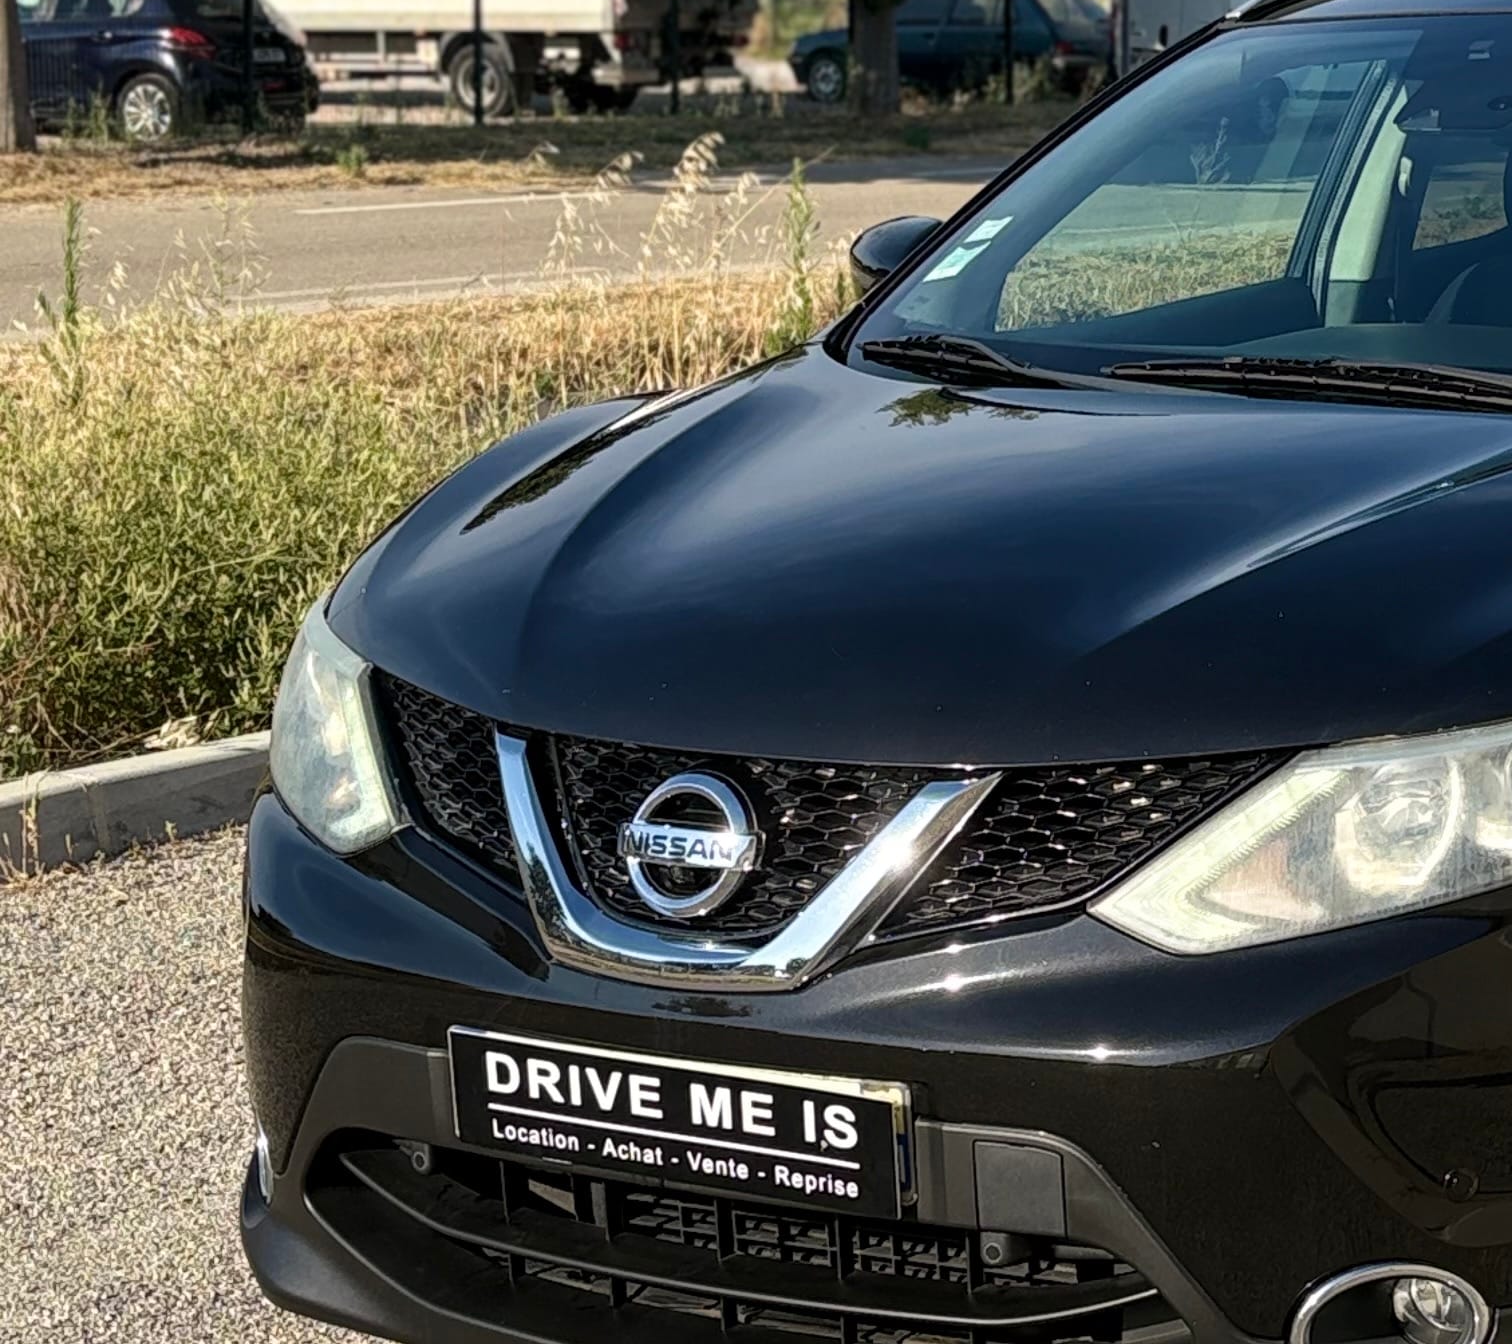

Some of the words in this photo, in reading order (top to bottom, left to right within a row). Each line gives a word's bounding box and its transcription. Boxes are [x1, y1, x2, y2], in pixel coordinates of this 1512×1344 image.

[625, 829, 733, 862] NISSAN
[485, 1050, 664, 1119] DRIVE
[689, 1082, 776, 1137] ME
[802, 1099, 858, 1150] IS
[492, 1118, 580, 1153] Location
[602, 1136, 664, 1166] Achat
[686, 1150, 749, 1181] Vente
[774, 1164, 859, 1199] Reprise
